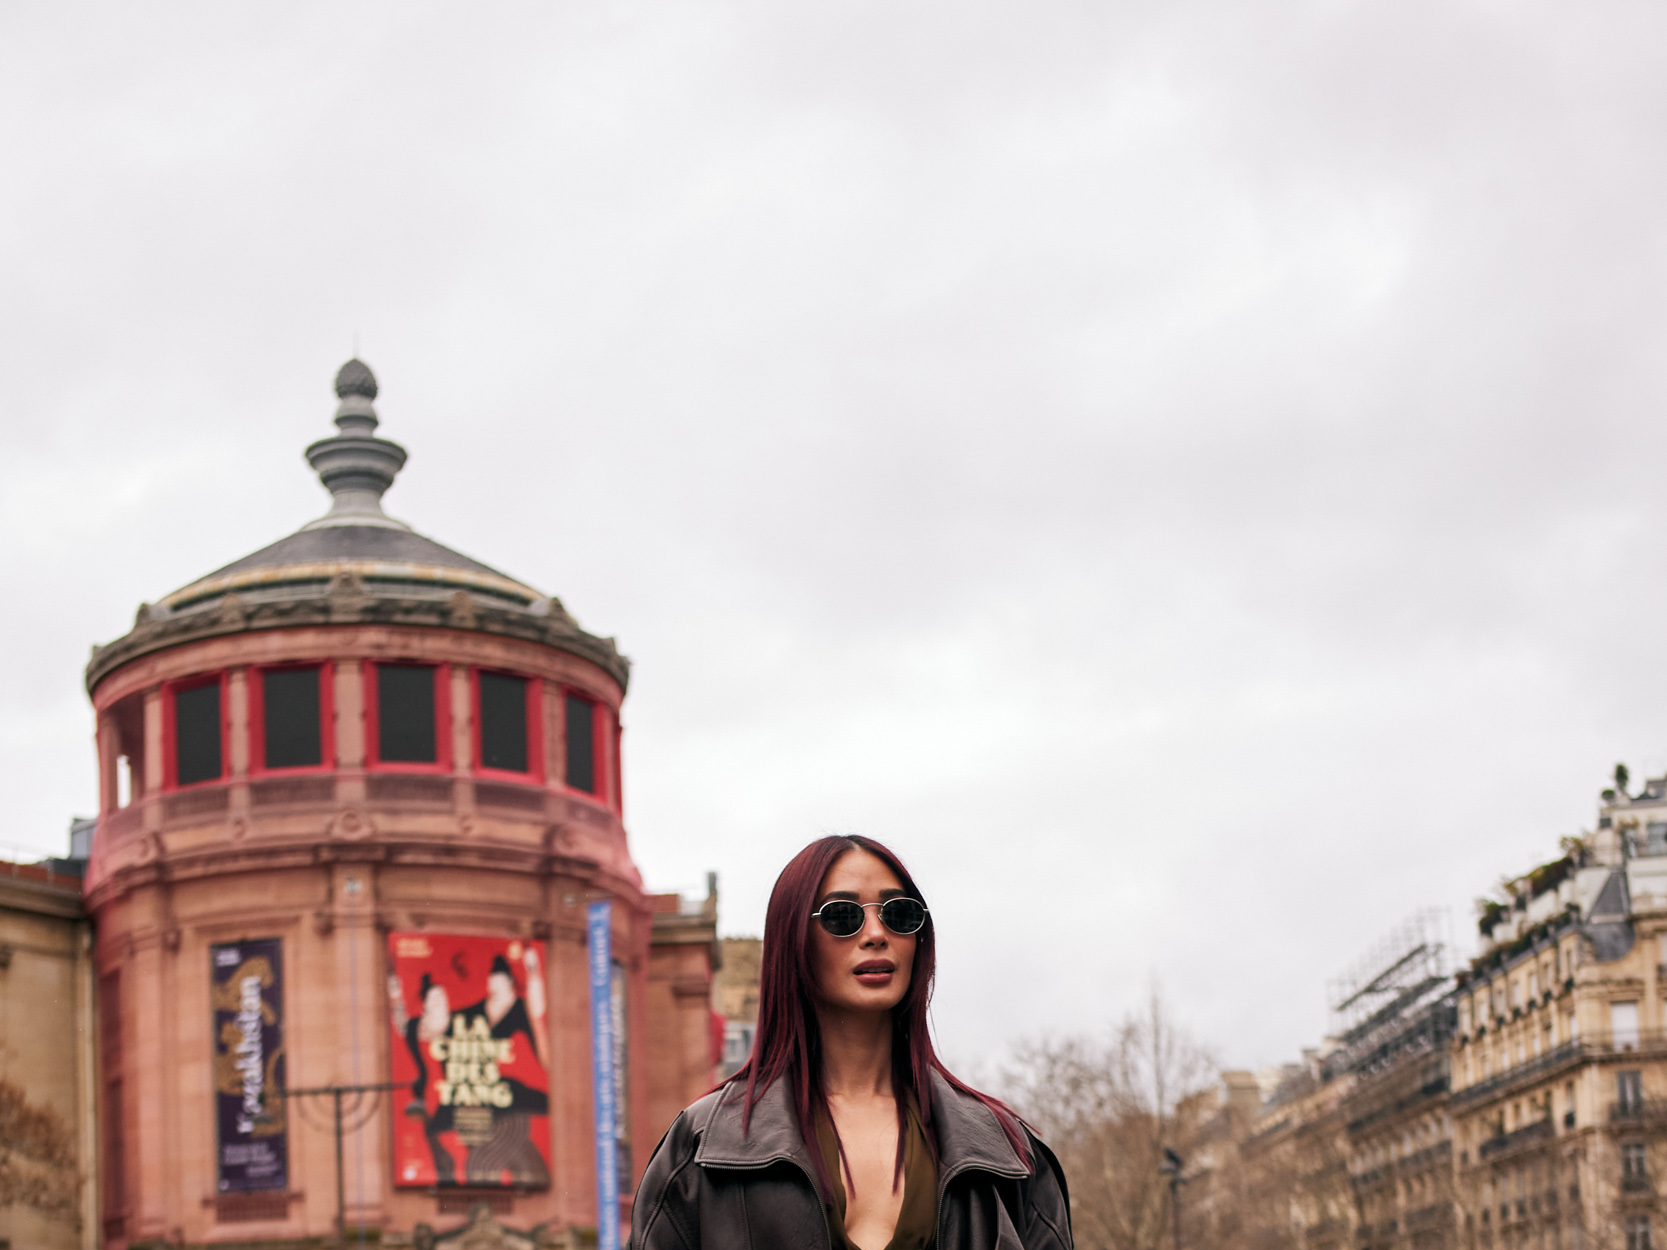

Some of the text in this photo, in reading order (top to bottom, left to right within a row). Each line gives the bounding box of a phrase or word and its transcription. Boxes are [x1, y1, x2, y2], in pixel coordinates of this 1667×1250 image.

[453, 1013, 490, 1040] LA
[429, 1038, 515, 1063] CHINE
[447, 1061, 500, 1084] DES
[434, 1081, 513, 1108] TANG
